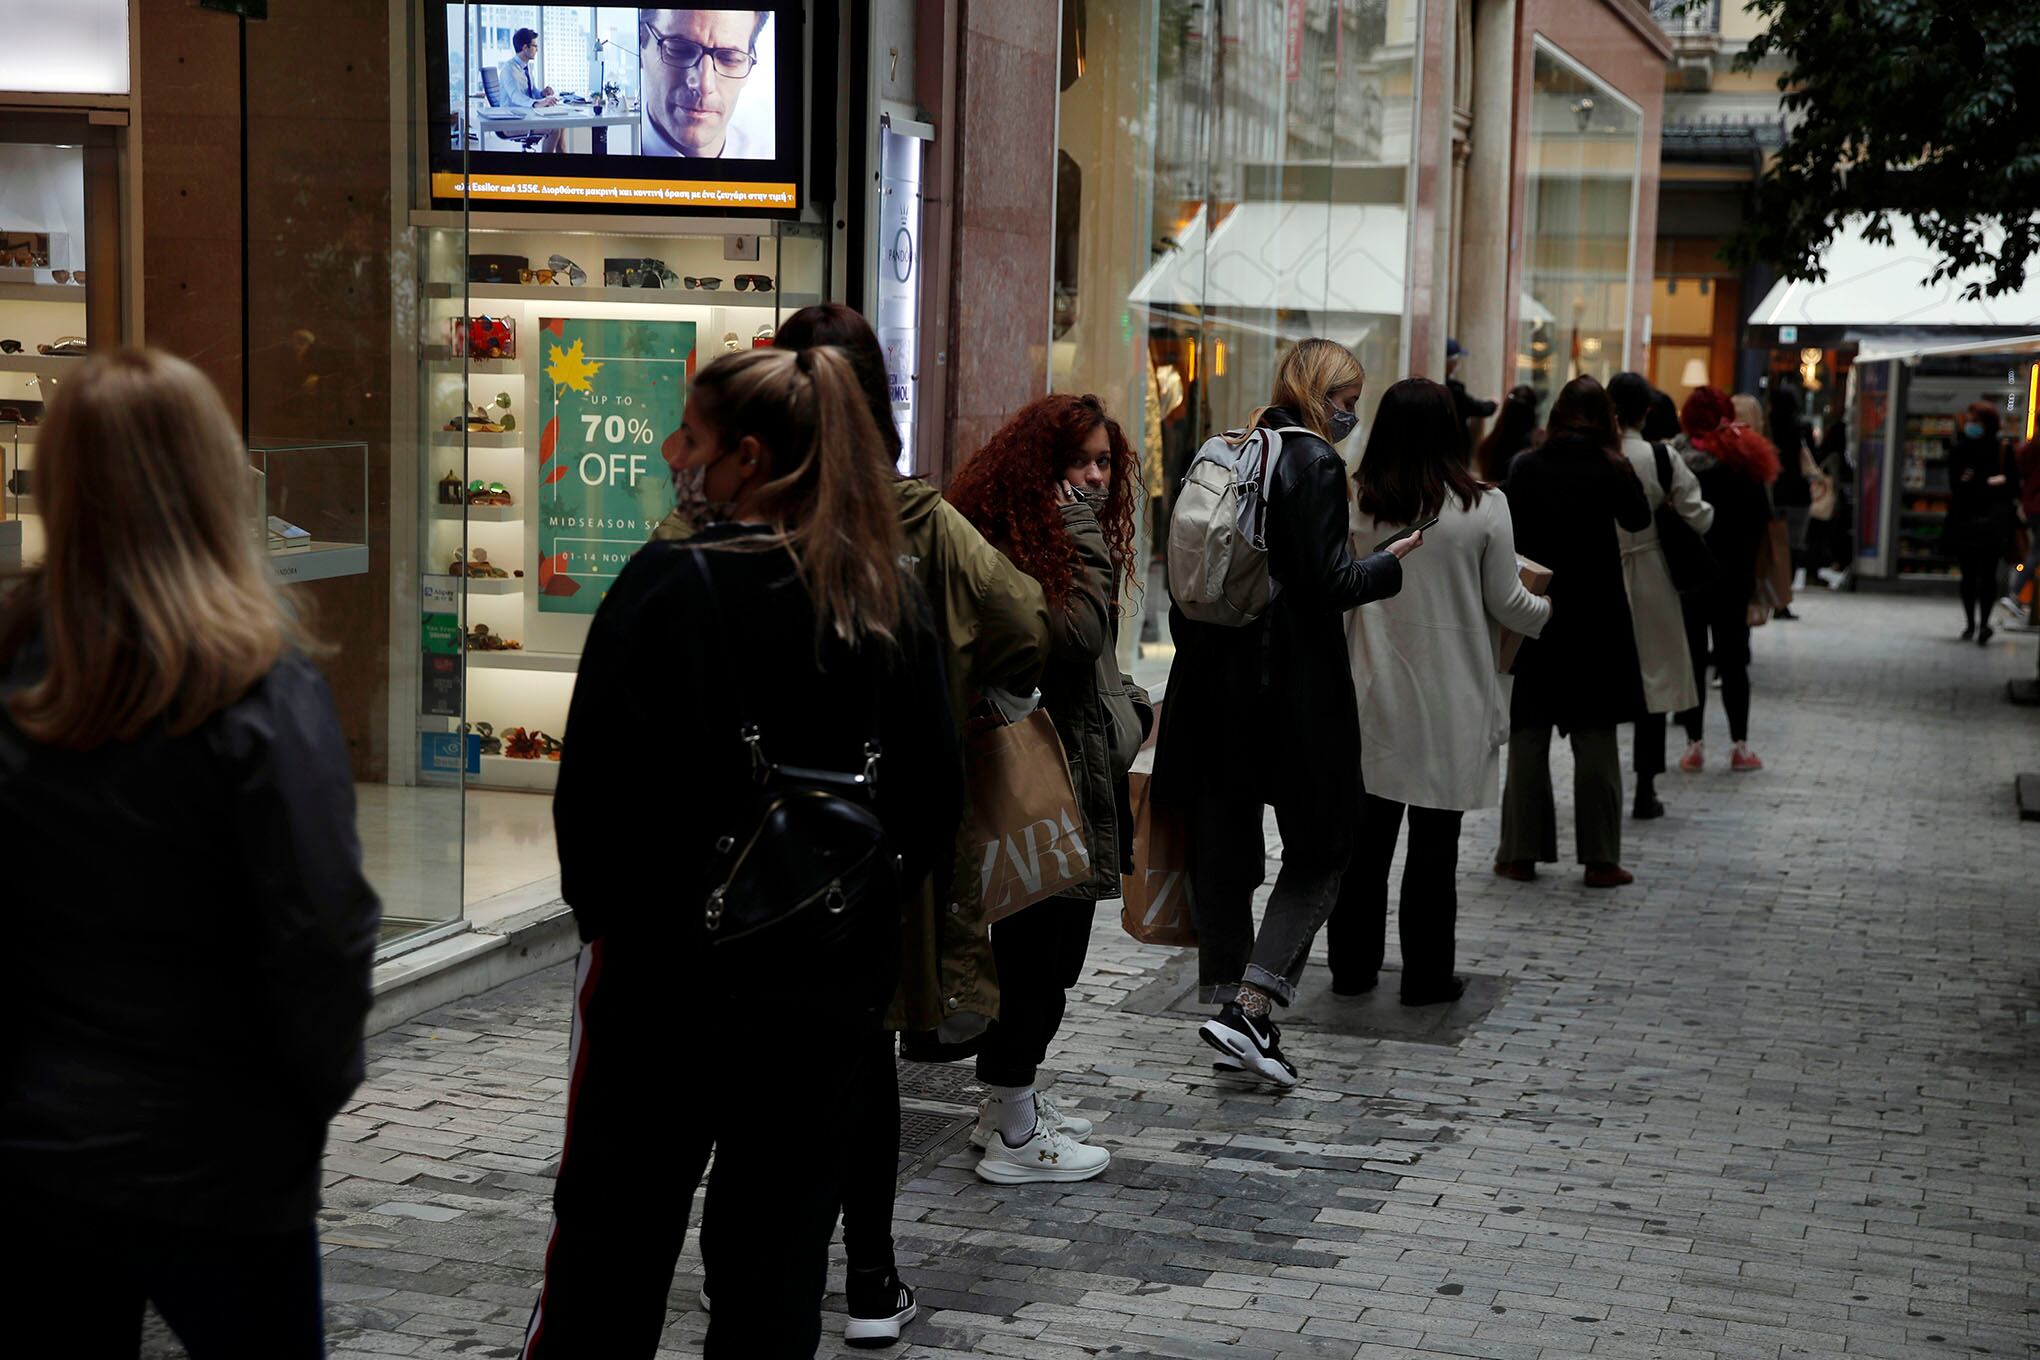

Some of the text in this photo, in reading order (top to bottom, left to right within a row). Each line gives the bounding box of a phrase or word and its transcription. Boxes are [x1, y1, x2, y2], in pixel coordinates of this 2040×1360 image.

[890, 47, 898, 82] 7
[472, 182, 499, 192] Essilor
[501, 185, 515, 194] από
[517, 183, 540, 194] 155€.
[542, 185, 584, 197] Διορθώστε
[585, 187, 617, 198] μακρινή
[634, 188, 663, 199] κοντινή
[664, 189, 689, 200] όραση
[691, 191, 701, 200] με
[702, 189, 716, 199] ένα
[717, 190, 747, 202] ζευγάρι
[748, 193, 768, 202] στην
[769, 192, 786, 202] τιμή
[591, 395, 633, 406] UP TO
[580, 414, 654, 445] 70%
[578, 452, 647, 487] OFF
[549, 516, 636, 529] MIDSEASON
[562, 552, 597, 561] 01-14
[979, 807, 1091, 908] ZARA
